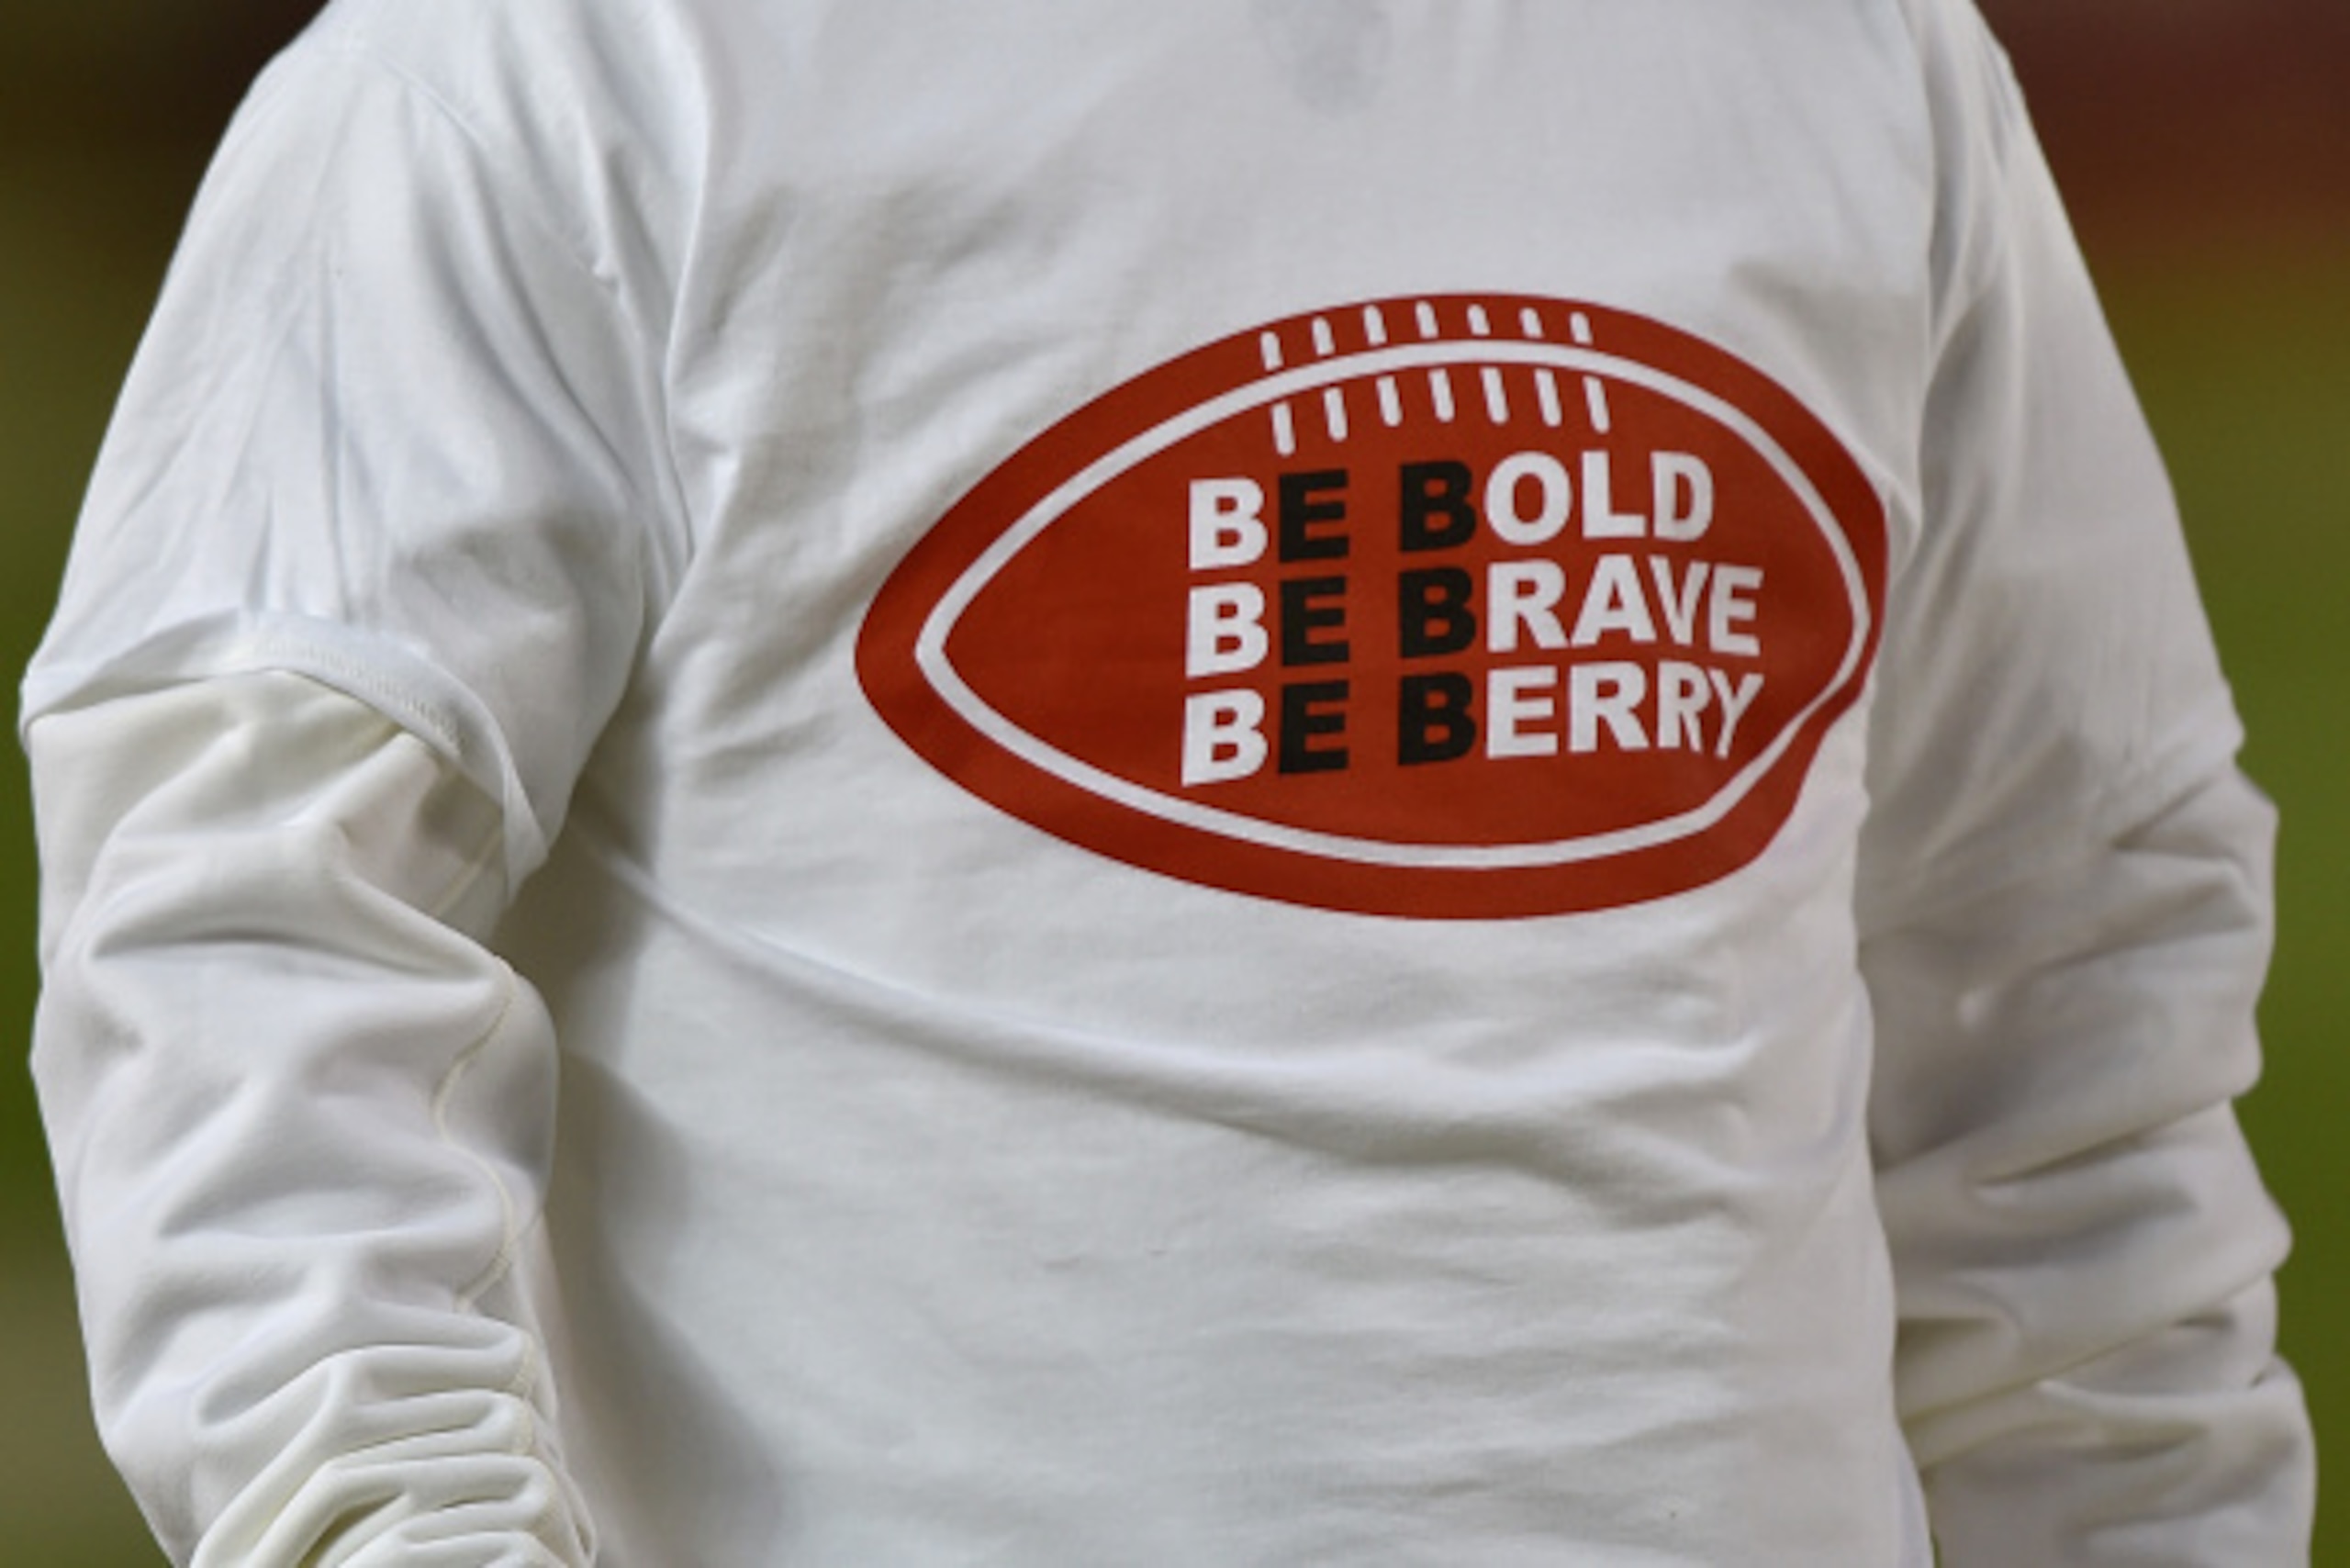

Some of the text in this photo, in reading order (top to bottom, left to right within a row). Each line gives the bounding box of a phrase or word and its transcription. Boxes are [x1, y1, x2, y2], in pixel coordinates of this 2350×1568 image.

[1188, 450, 1714, 570] BE BOLD
[1185, 554, 1764, 678] BE BRAVE
[1181, 661, 1764, 787] BE BERRY
